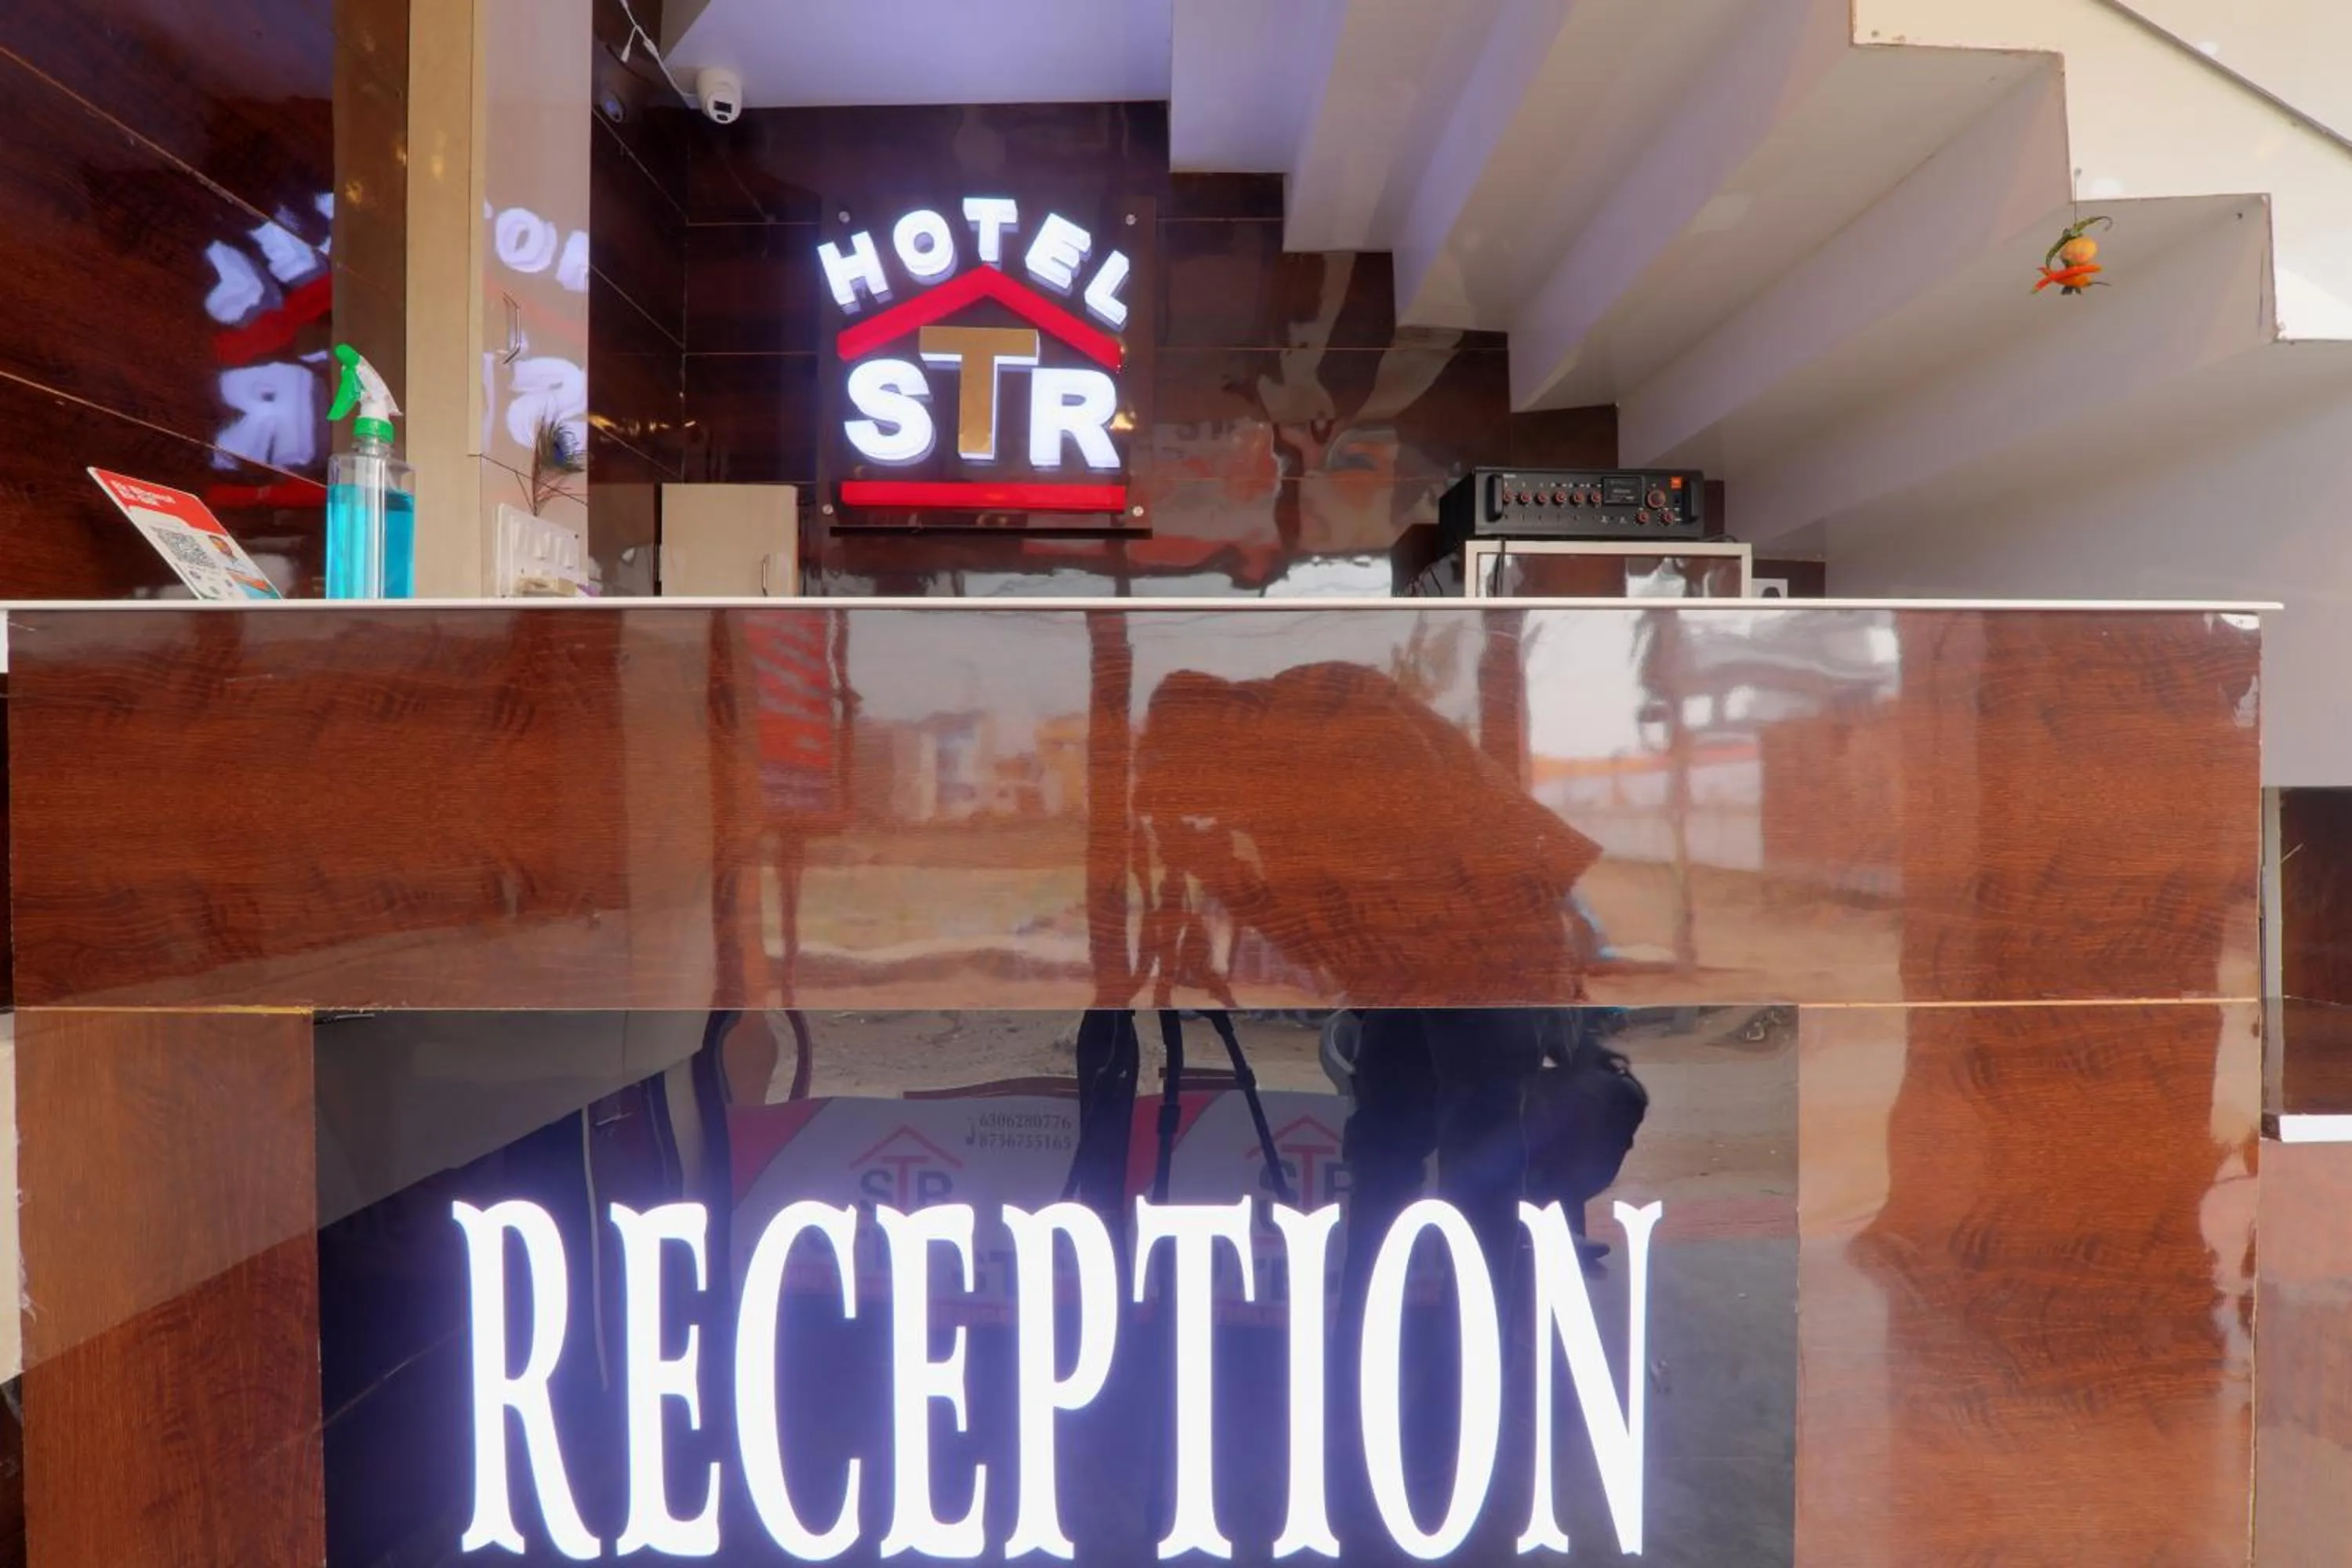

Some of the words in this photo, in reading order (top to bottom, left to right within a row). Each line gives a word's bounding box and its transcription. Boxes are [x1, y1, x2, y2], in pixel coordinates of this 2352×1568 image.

[817, 198, 1131, 328] HOTEL
[844, 326, 1121, 469] STR
[452, 1195, 1663, 1561] RECEPTION
